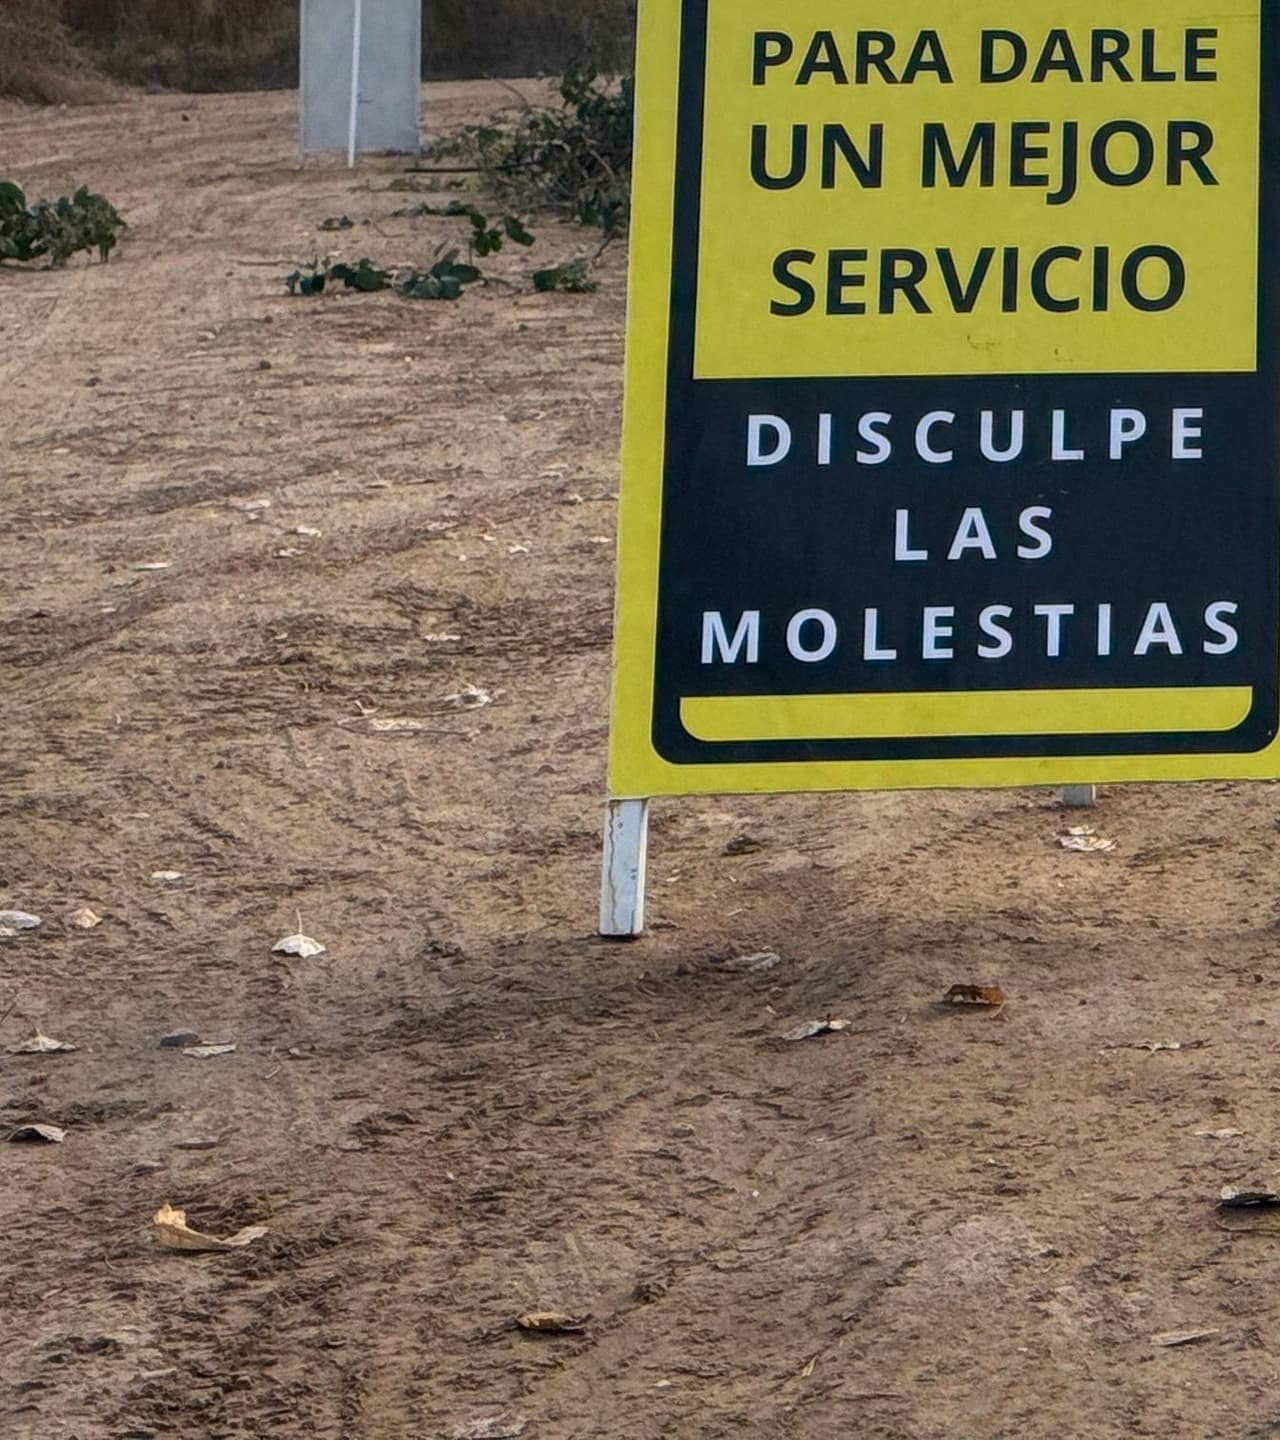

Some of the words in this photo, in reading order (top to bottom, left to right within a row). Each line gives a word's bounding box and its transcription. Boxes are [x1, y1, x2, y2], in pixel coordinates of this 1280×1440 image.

[751, 28, 955, 87] PARA
[979, 27, 1220, 85] DARLE
[749, 122, 885, 191] UN
[920, 119, 1220, 206] MEJOR
[768, 243, 1188, 317] SERVICIO
[745, 406, 1205, 467] DISCULPE
[893, 505, 1055, 562] LAS
[700, 600, 1240, 665] MOLESTIAS
